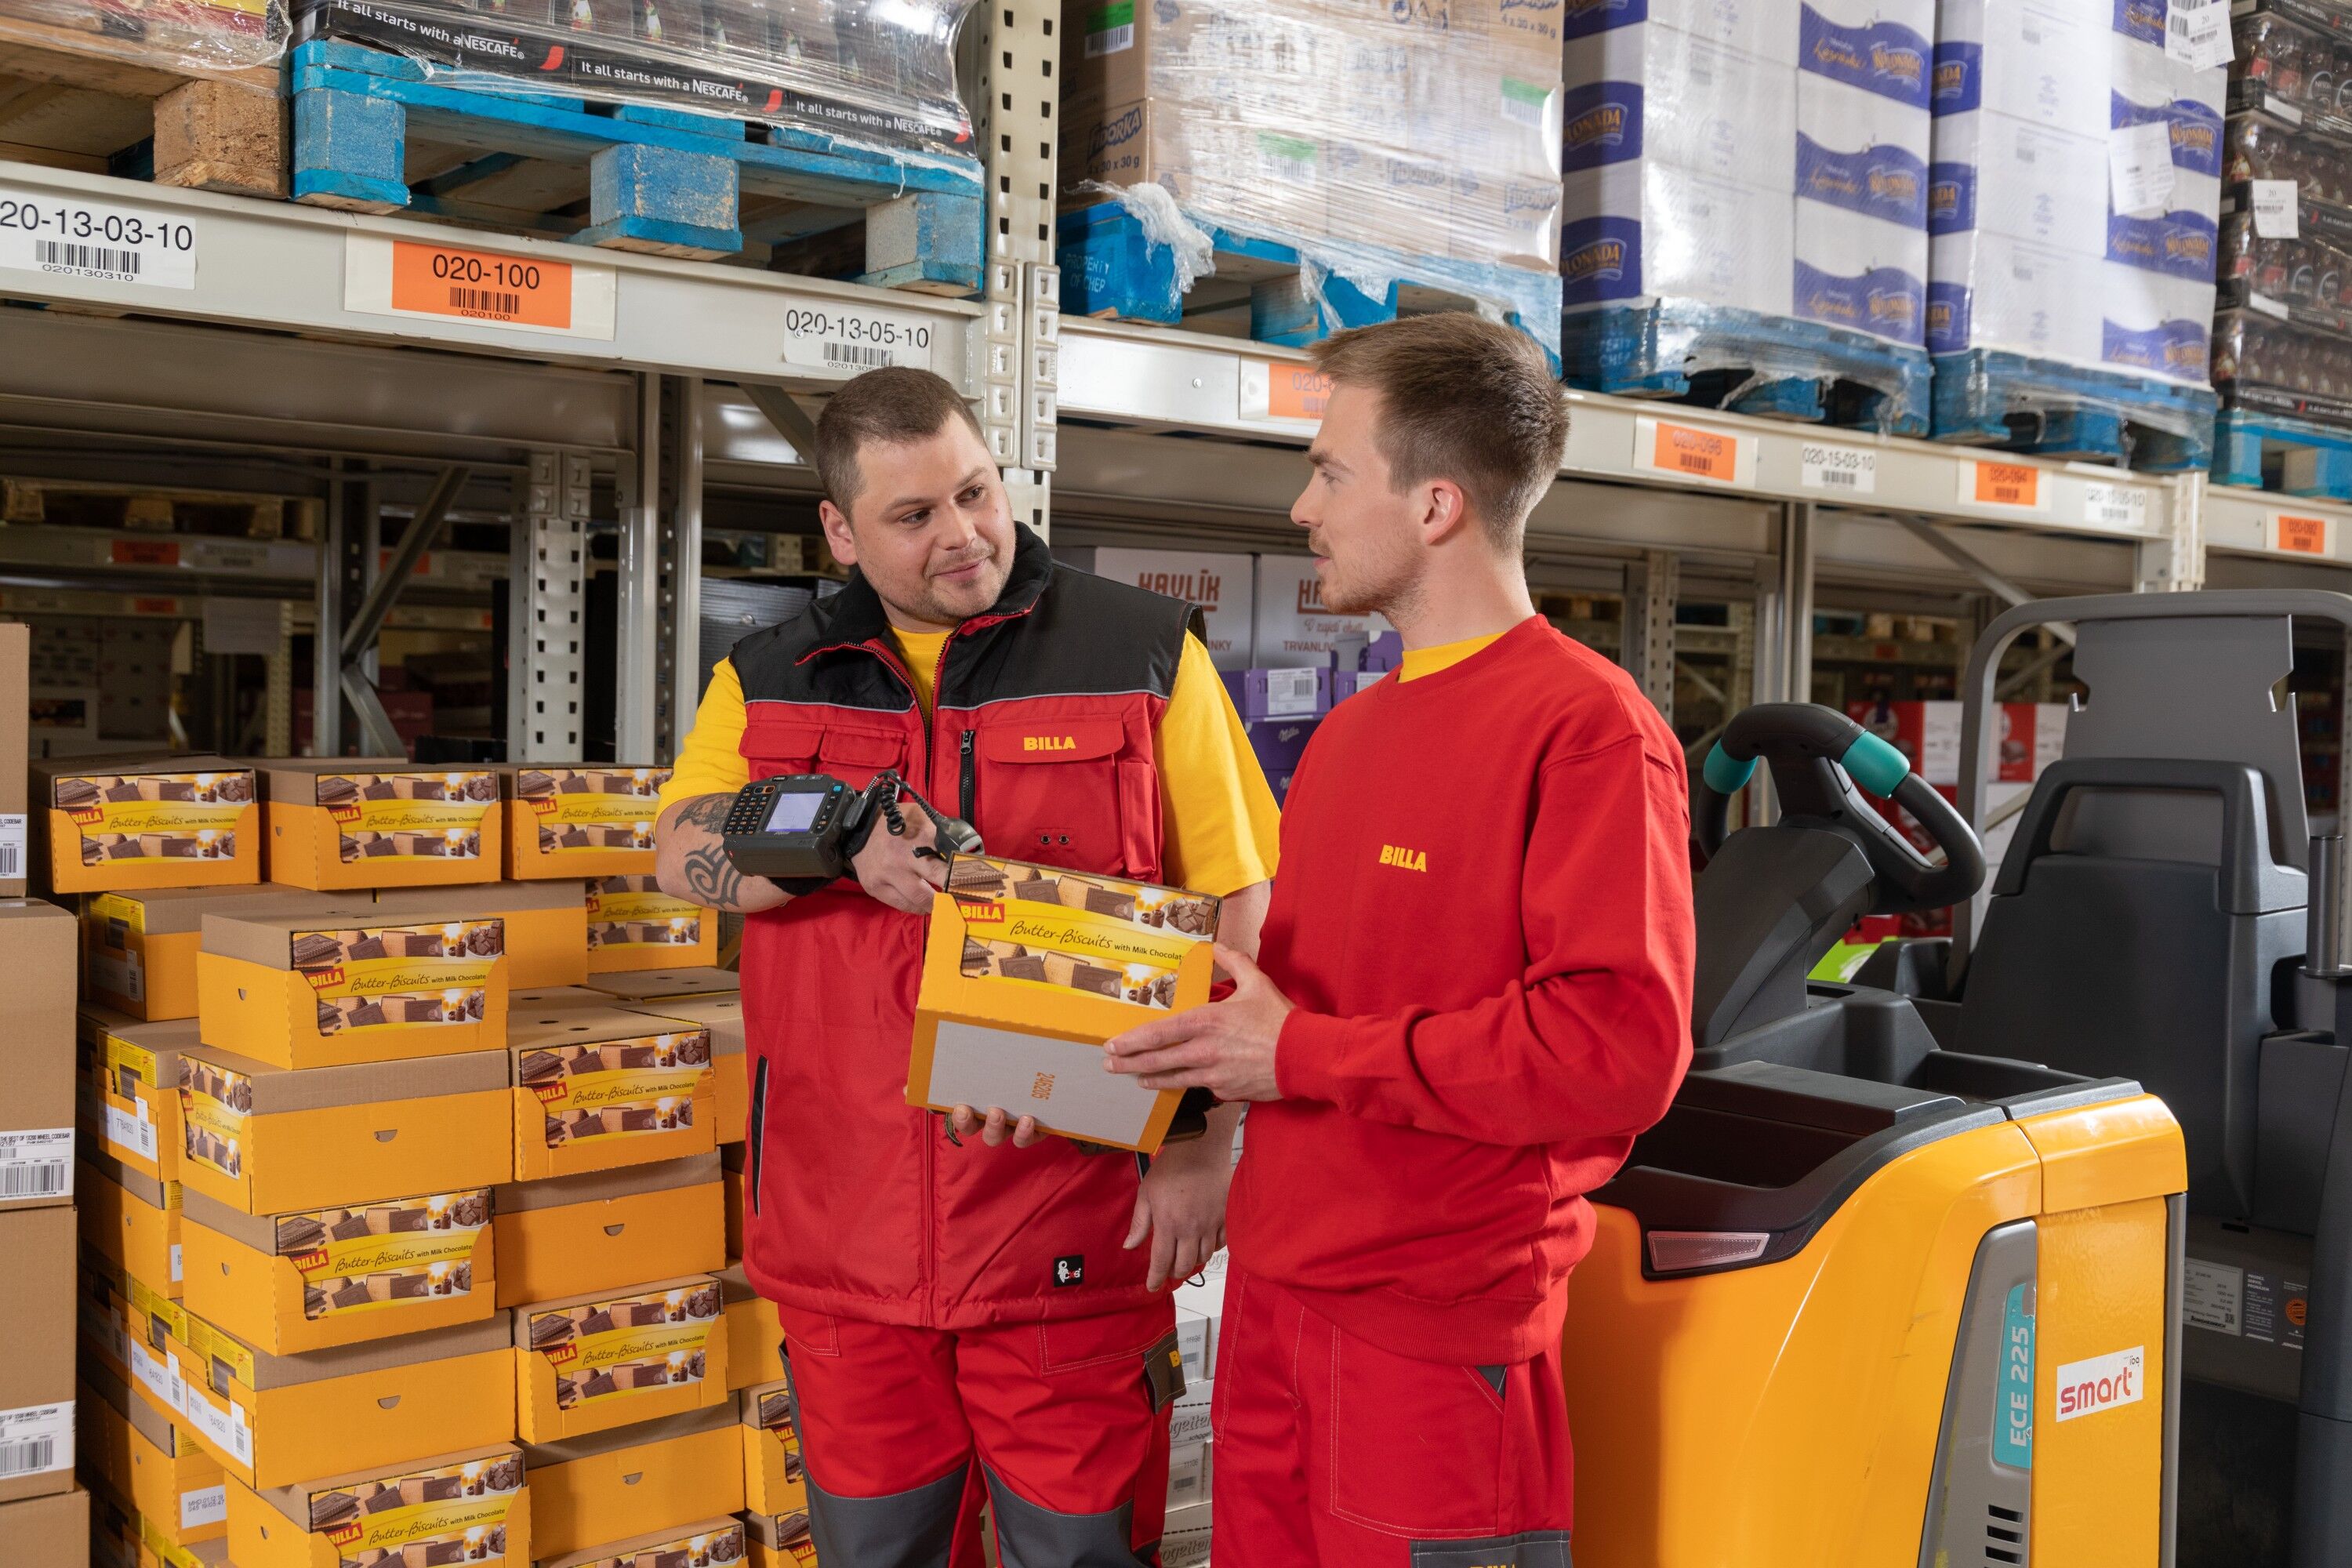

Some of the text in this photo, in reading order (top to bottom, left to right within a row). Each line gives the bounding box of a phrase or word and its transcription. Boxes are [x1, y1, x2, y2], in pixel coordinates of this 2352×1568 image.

[353, 2, 372, 17] all
[375, 10, 416, 32] starts
[420, 24, 450, 42] with
[452, 35, 461, 47] a
[582, 61, 591, 74] It
[594, 64, 612, 77] all
[615, 68, 650, 84] starts
[653, 76, 680, 89] with
[682, 82, 690, 92] a
[797, 100, 805, 112] It
[808, 103, 823, 115] all
[826, 107, 858, 122] starts
[860, 114, 883, 128] with
[885, 120, 891, 129] a
[1120, 156, 1131, 168] 30
[1133, 155, 1141, 169] g
[42, 264, 133, 281] 020130310
[433, 254, 540, 289] 020-100
[1083, 275, 1105, 292] CHEP
[461, 309, 510, 321] 020100
[786, 309, 929, 348] 020-13-05-10
[1802, 447, 1875, 470] 020-15-03-10
[1208, 641, 1232, 651] INKY
[1024, 736, 1076, 751] BILLA
[109, 815, 184, 830] Butter-Biscuits
[366, 814, 434, 828] Butter-Biscuits
[561, 808, 623, 820] Butter-Biscuits
[1379, 844, 1427, 872] BILLA
[604, 907, 660, 919] Butter-Biscuits
[964, 905, 1002, 920] BILLA
[1010, 921, 1112, 949] Butter-Biscuits
[1114, 943, 1131, 952] with
[1132, 945, 1148, 955] Milk
[351, 974, 431, 993] Butter-Biscuits
[573, 1084, 644, 1105] Butter-Biscuits
[670, 1082, 695, 1091] Chocolate
[1031, 1072, 1055, 1100] 246205
[335, 1248, 416, 1273] Butter-Biscuits
[444, 1244, 473, 1254] Chocolate
[583, 1341, 655, 1366] Butter-Biscuits
[679, 1334, 705, 1344] Chocolate
[2011, 1326, 2029, 1384] 225
[2061, 1367, 2132, 1414] smart
[2009, 1392, 2028, 1446] ECE
[369, 1516, 449, 1546] Butter-Biscuits
[464, 1514, 476, 1523] Milk
[477, 1508, 506, 1519] Chocolate
